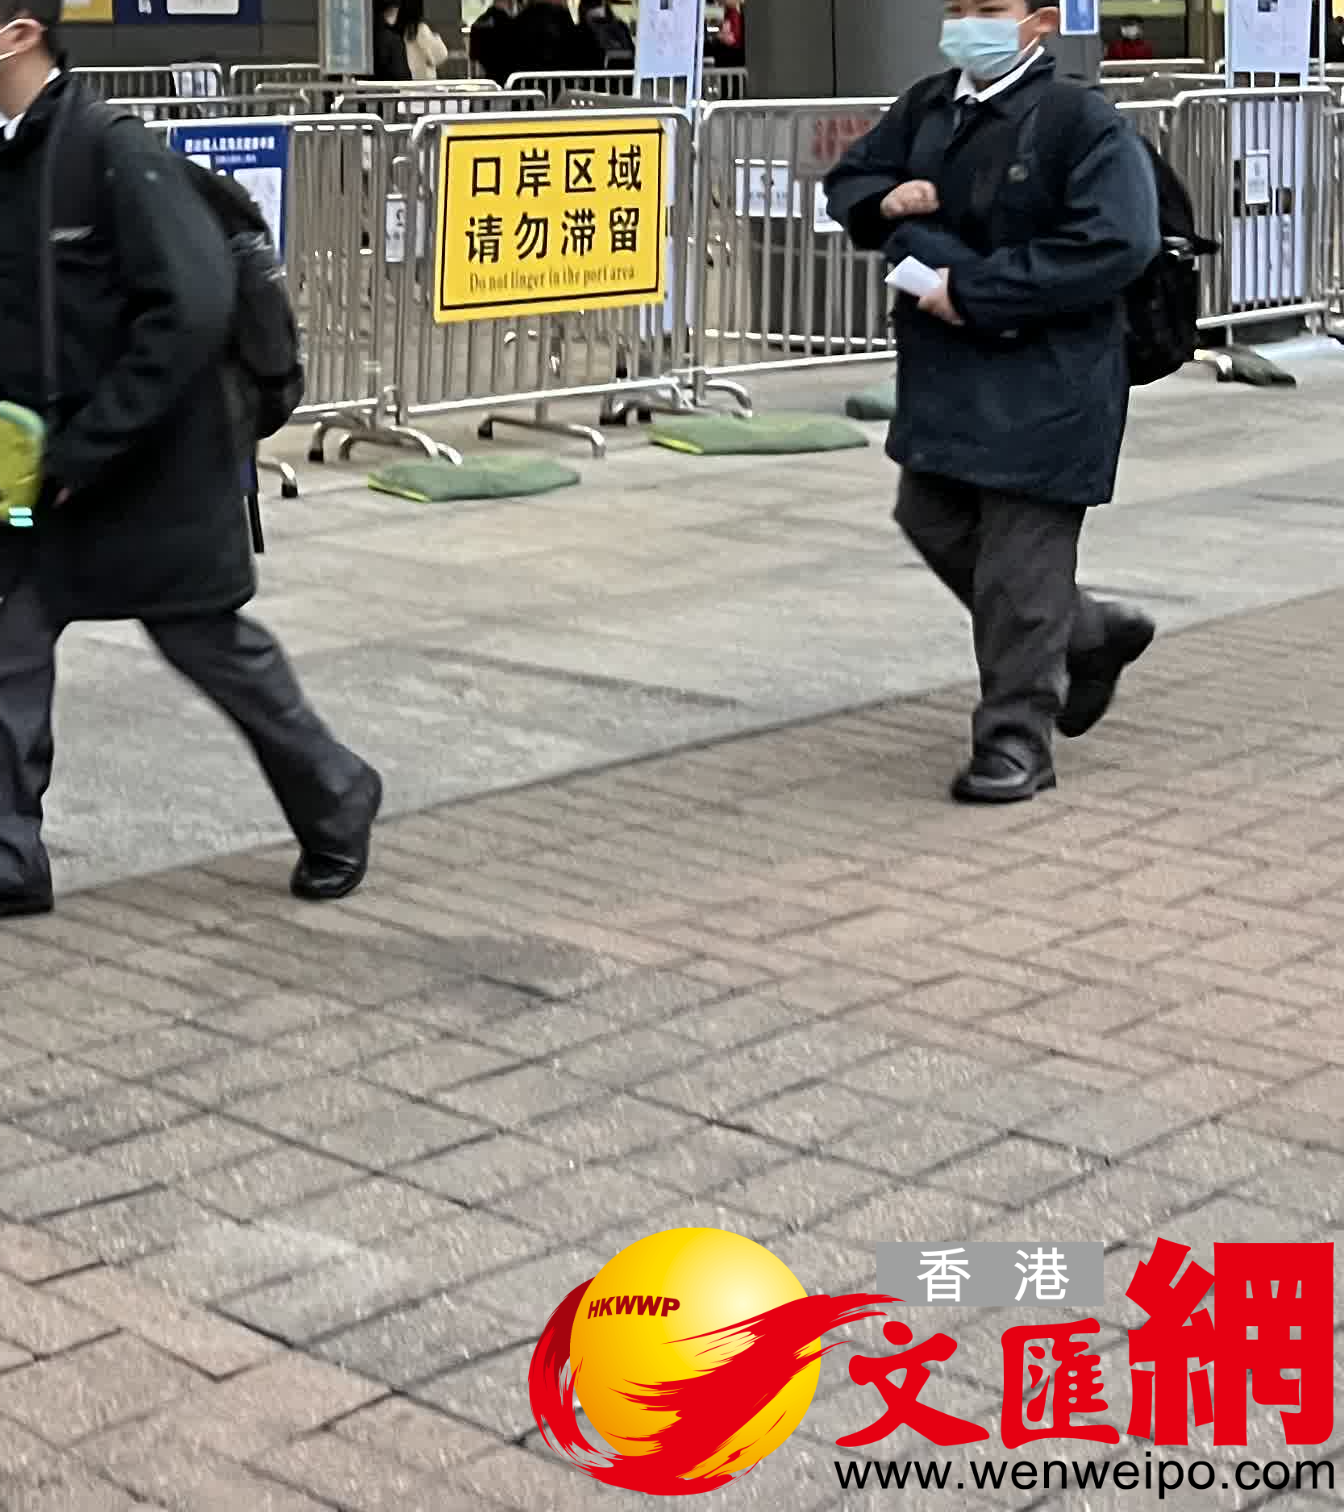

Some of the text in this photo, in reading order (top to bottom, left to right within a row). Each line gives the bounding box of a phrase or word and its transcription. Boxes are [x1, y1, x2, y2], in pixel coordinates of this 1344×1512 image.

[471, 144, 643, 197] 口岸区域
[465, 207, 641, 264] 请勿滞留
